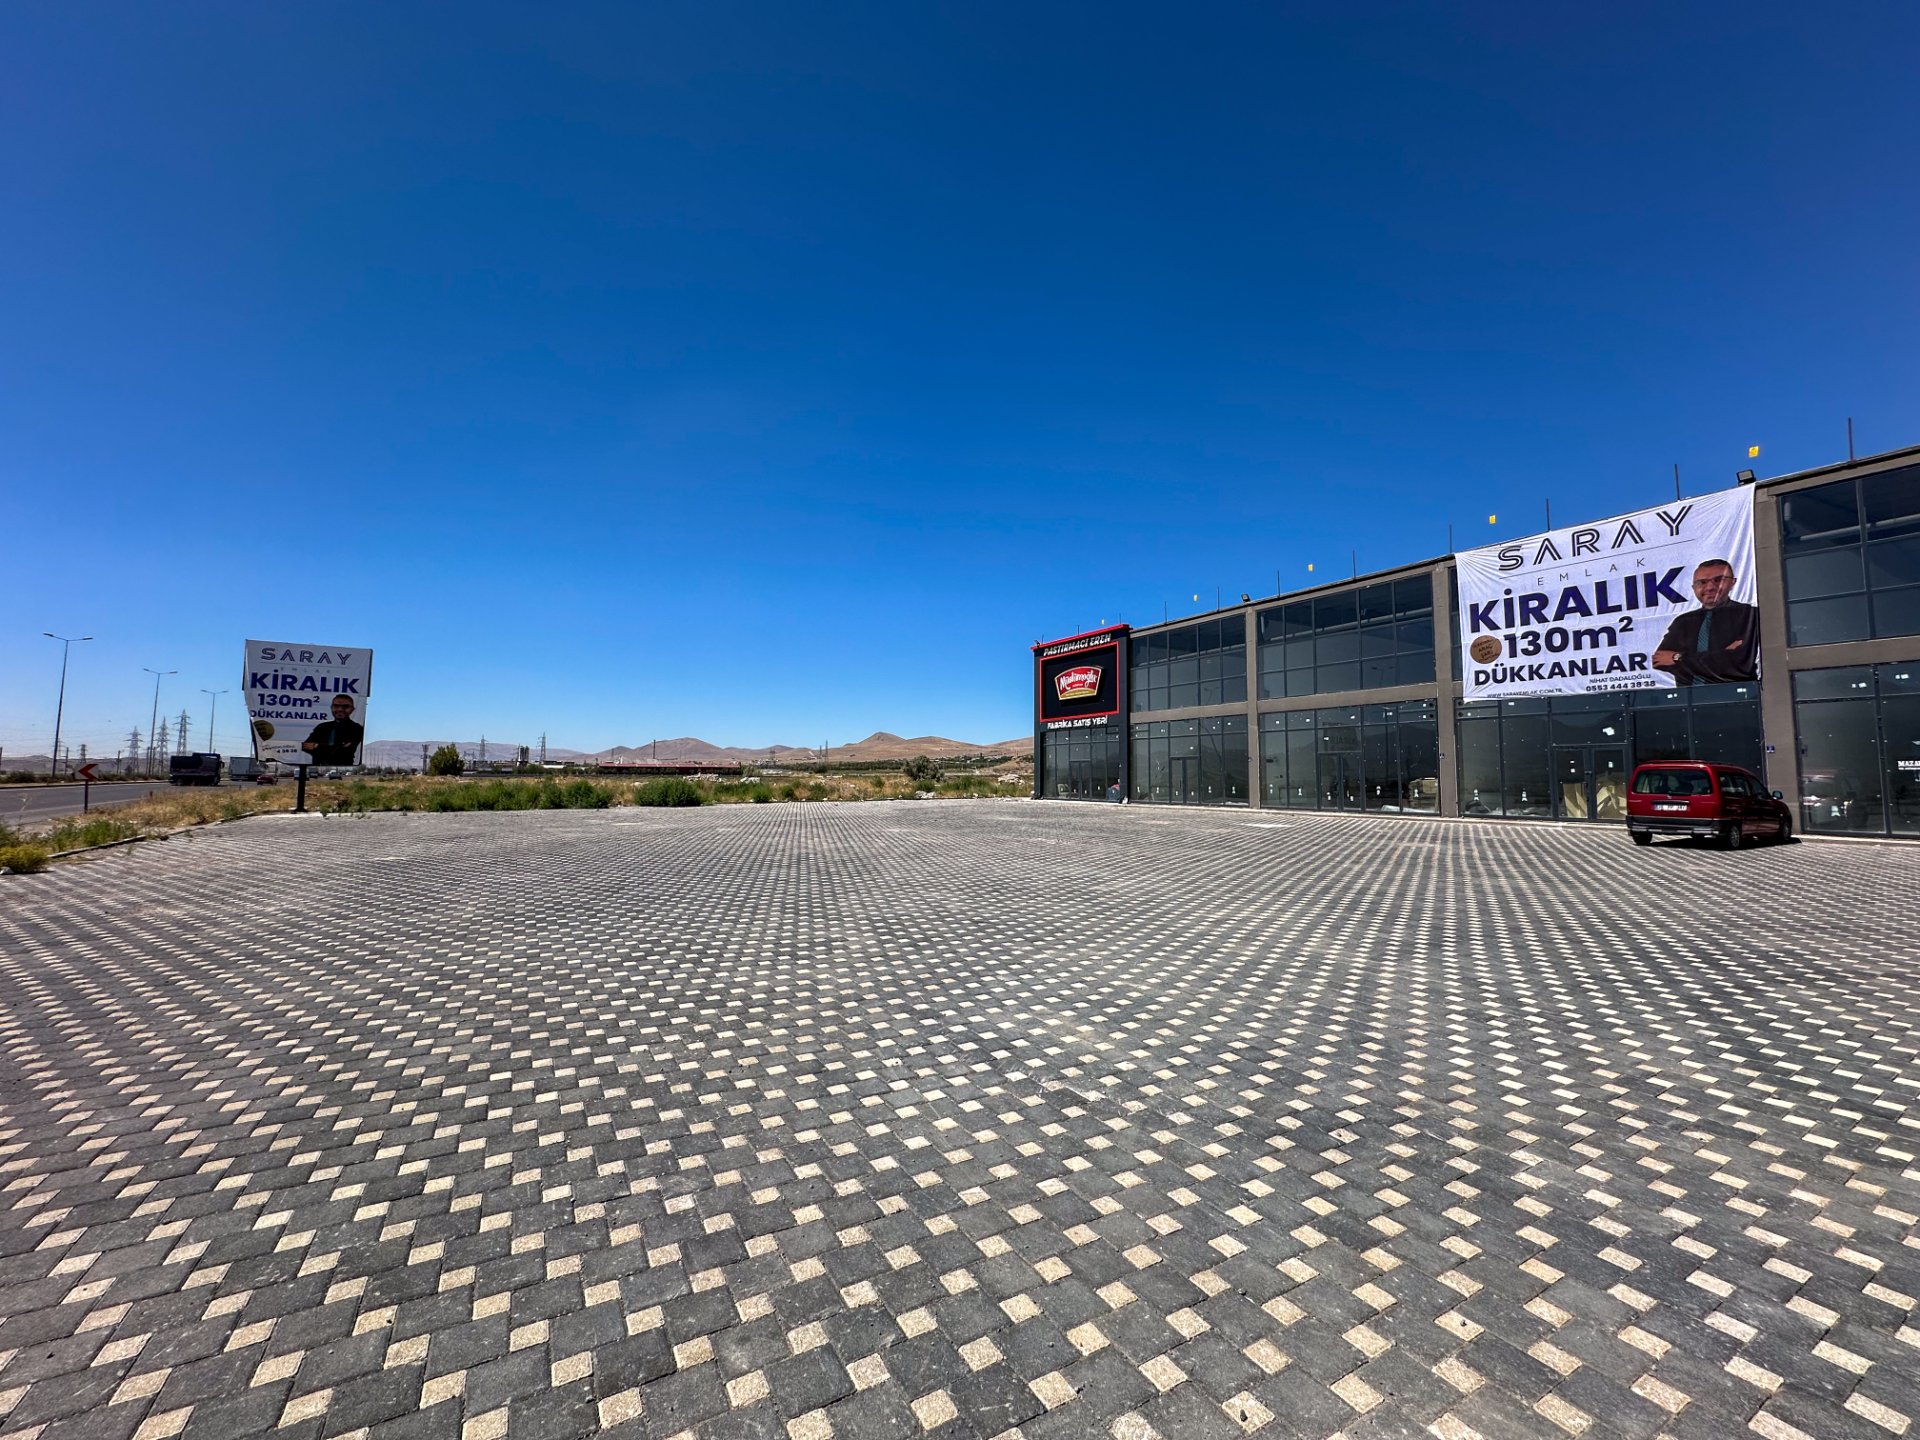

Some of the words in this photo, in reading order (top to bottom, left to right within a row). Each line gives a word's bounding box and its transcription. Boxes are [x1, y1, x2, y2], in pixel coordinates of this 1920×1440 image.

[1497, 504, 1693, 571] SARAY
[1537, 557, 1646, 586] EMLAK
[1469, 566, 1688, 633] KİRALIK
[1090, 633, 1112, 646] EREN
[261, 647, 352, 665] SARAY
[1474, 652, 1648, 686] DÜKKANLAR
[250, 669, 360, 693] KİRALIK
[1585, 684, 1608, 692] 0553
[250, 708, 328, 720] DÜKKANLAR
[1047, 719, 1072, 729] FABRİKA
[1073, 718, 1091, 727] SATIŞ
[1092, 714, 1108, 724] YERİ
